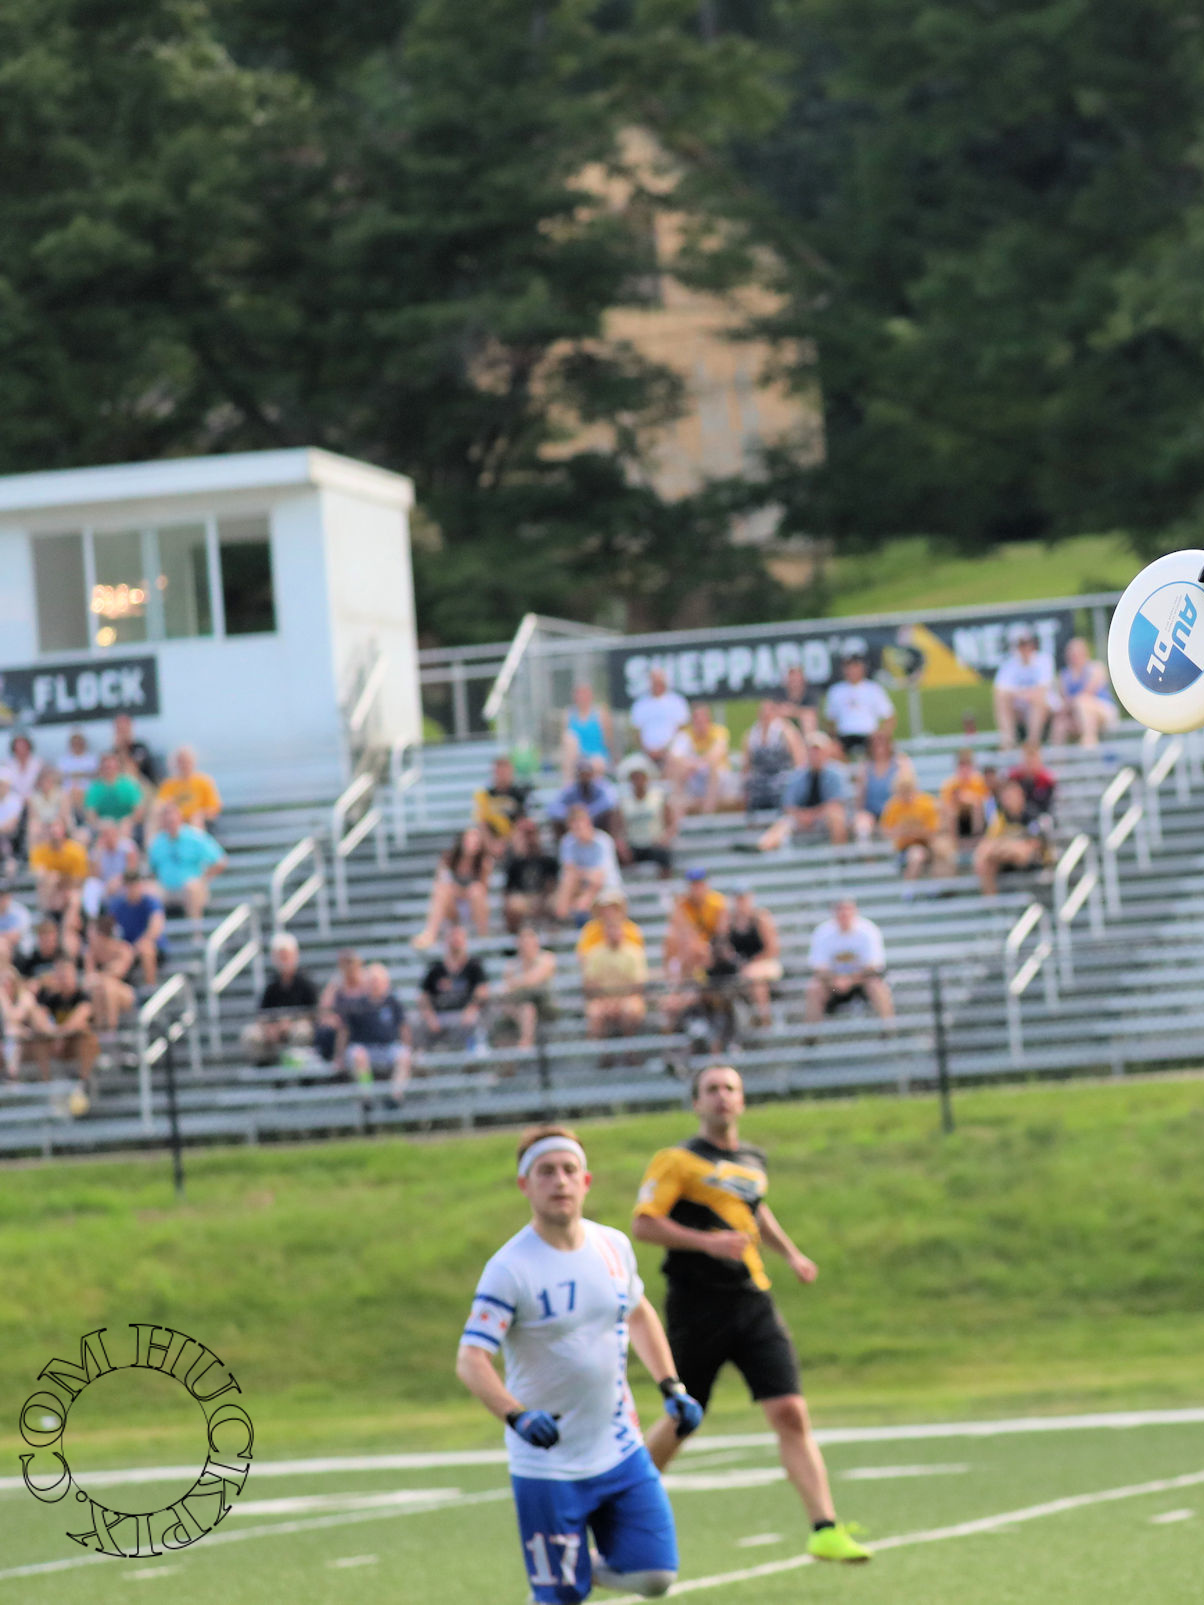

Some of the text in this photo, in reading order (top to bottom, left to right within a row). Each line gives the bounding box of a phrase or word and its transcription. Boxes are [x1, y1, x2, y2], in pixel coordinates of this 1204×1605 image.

[1146, 593, 1197, 675] AUDL
[33, 665, 145, 714] FLOCK
[536, 1280, 576, 1321] 17
[525, 1532, 581, 1586] 17
